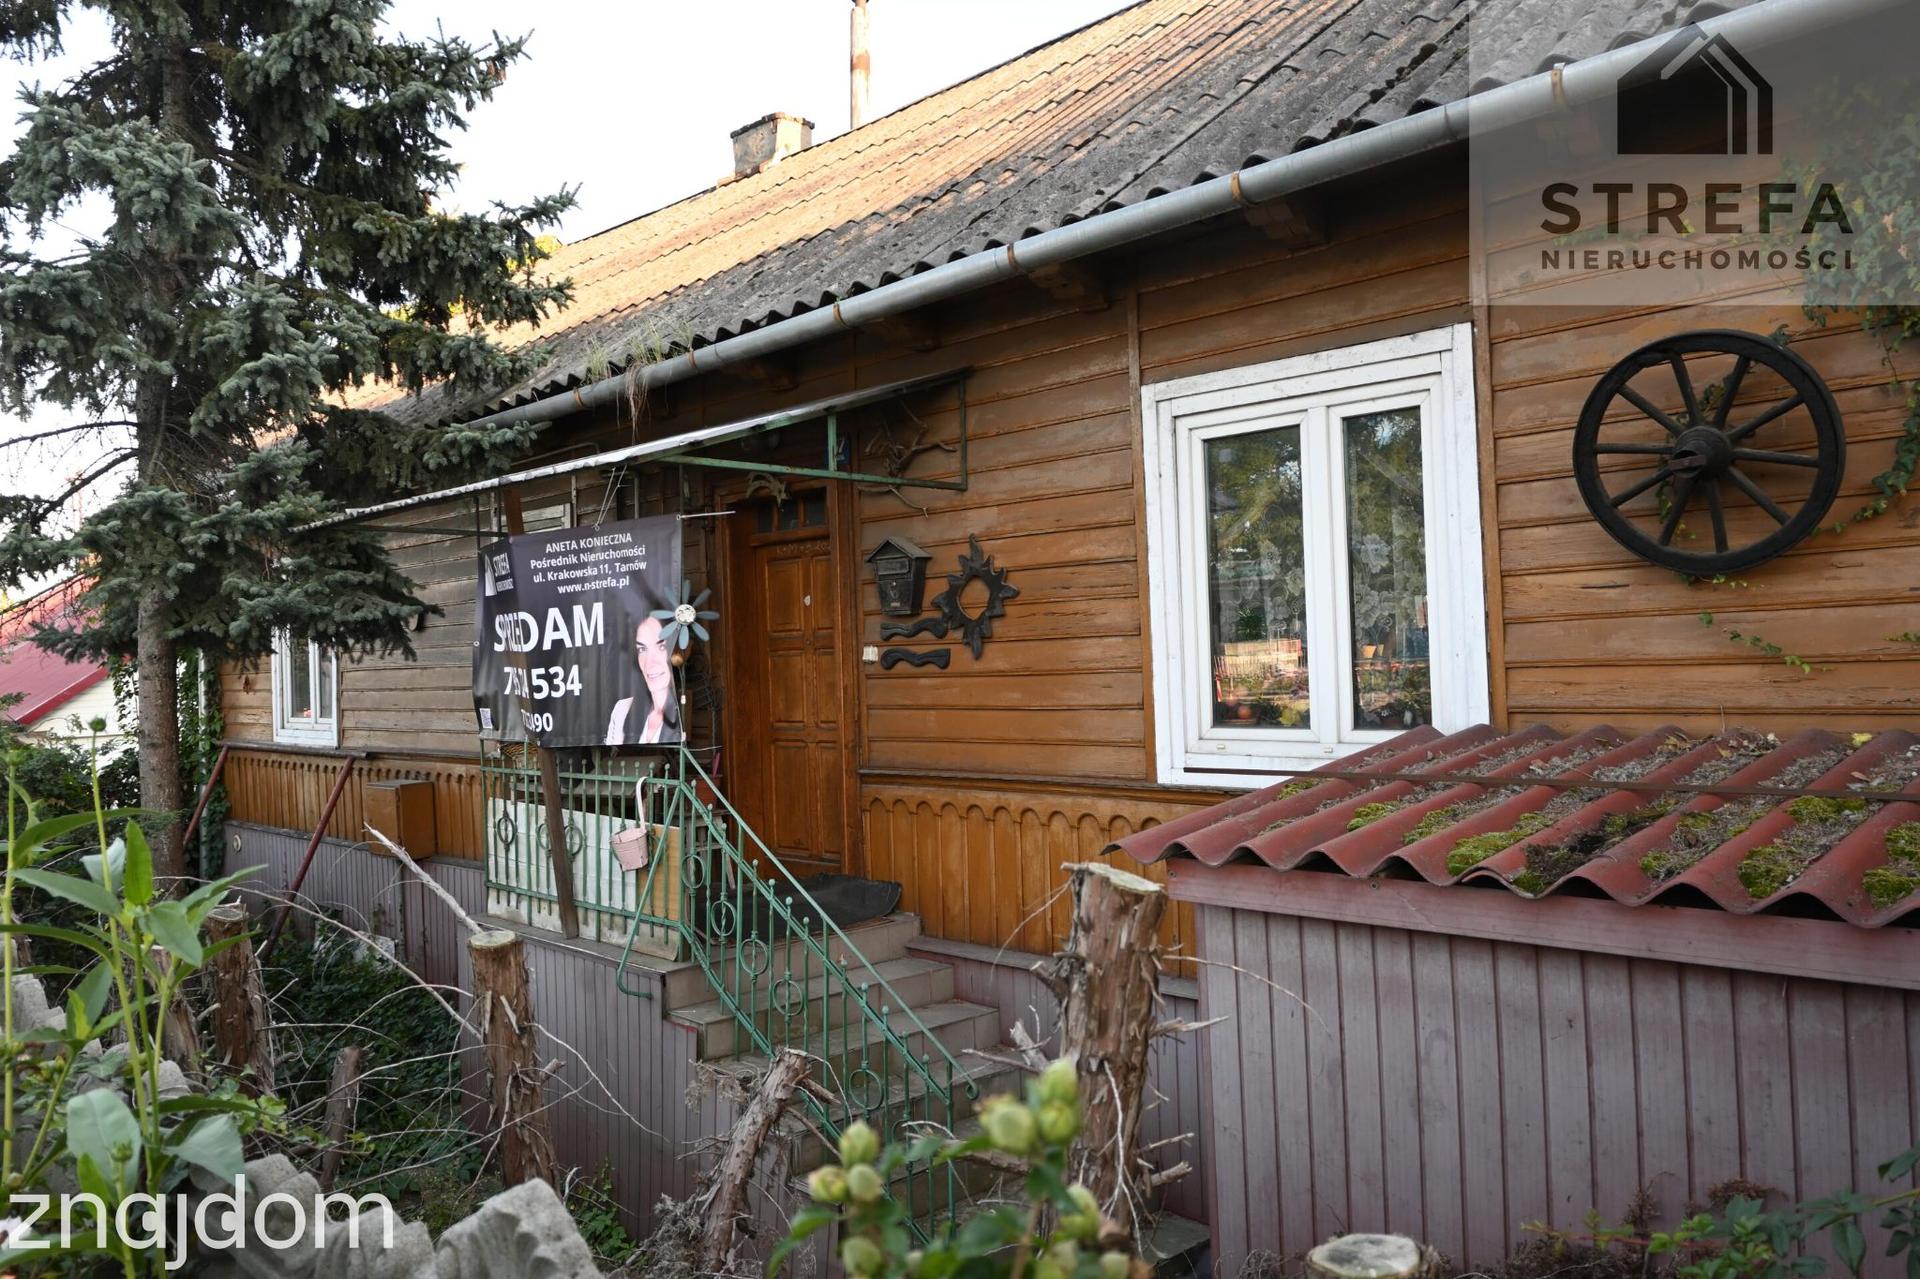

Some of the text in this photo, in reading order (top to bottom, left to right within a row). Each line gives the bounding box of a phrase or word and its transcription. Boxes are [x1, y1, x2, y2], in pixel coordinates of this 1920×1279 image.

[545, 533, 632, 553] ANETA KONIECZNA
[530, 545, 646, 569] Pośrednik Nieruchomości
[533, 559, 647, 583] ul. Krakowska 11, Tarnów
[557, 575, 630, 594] www.n-strefa.pl
